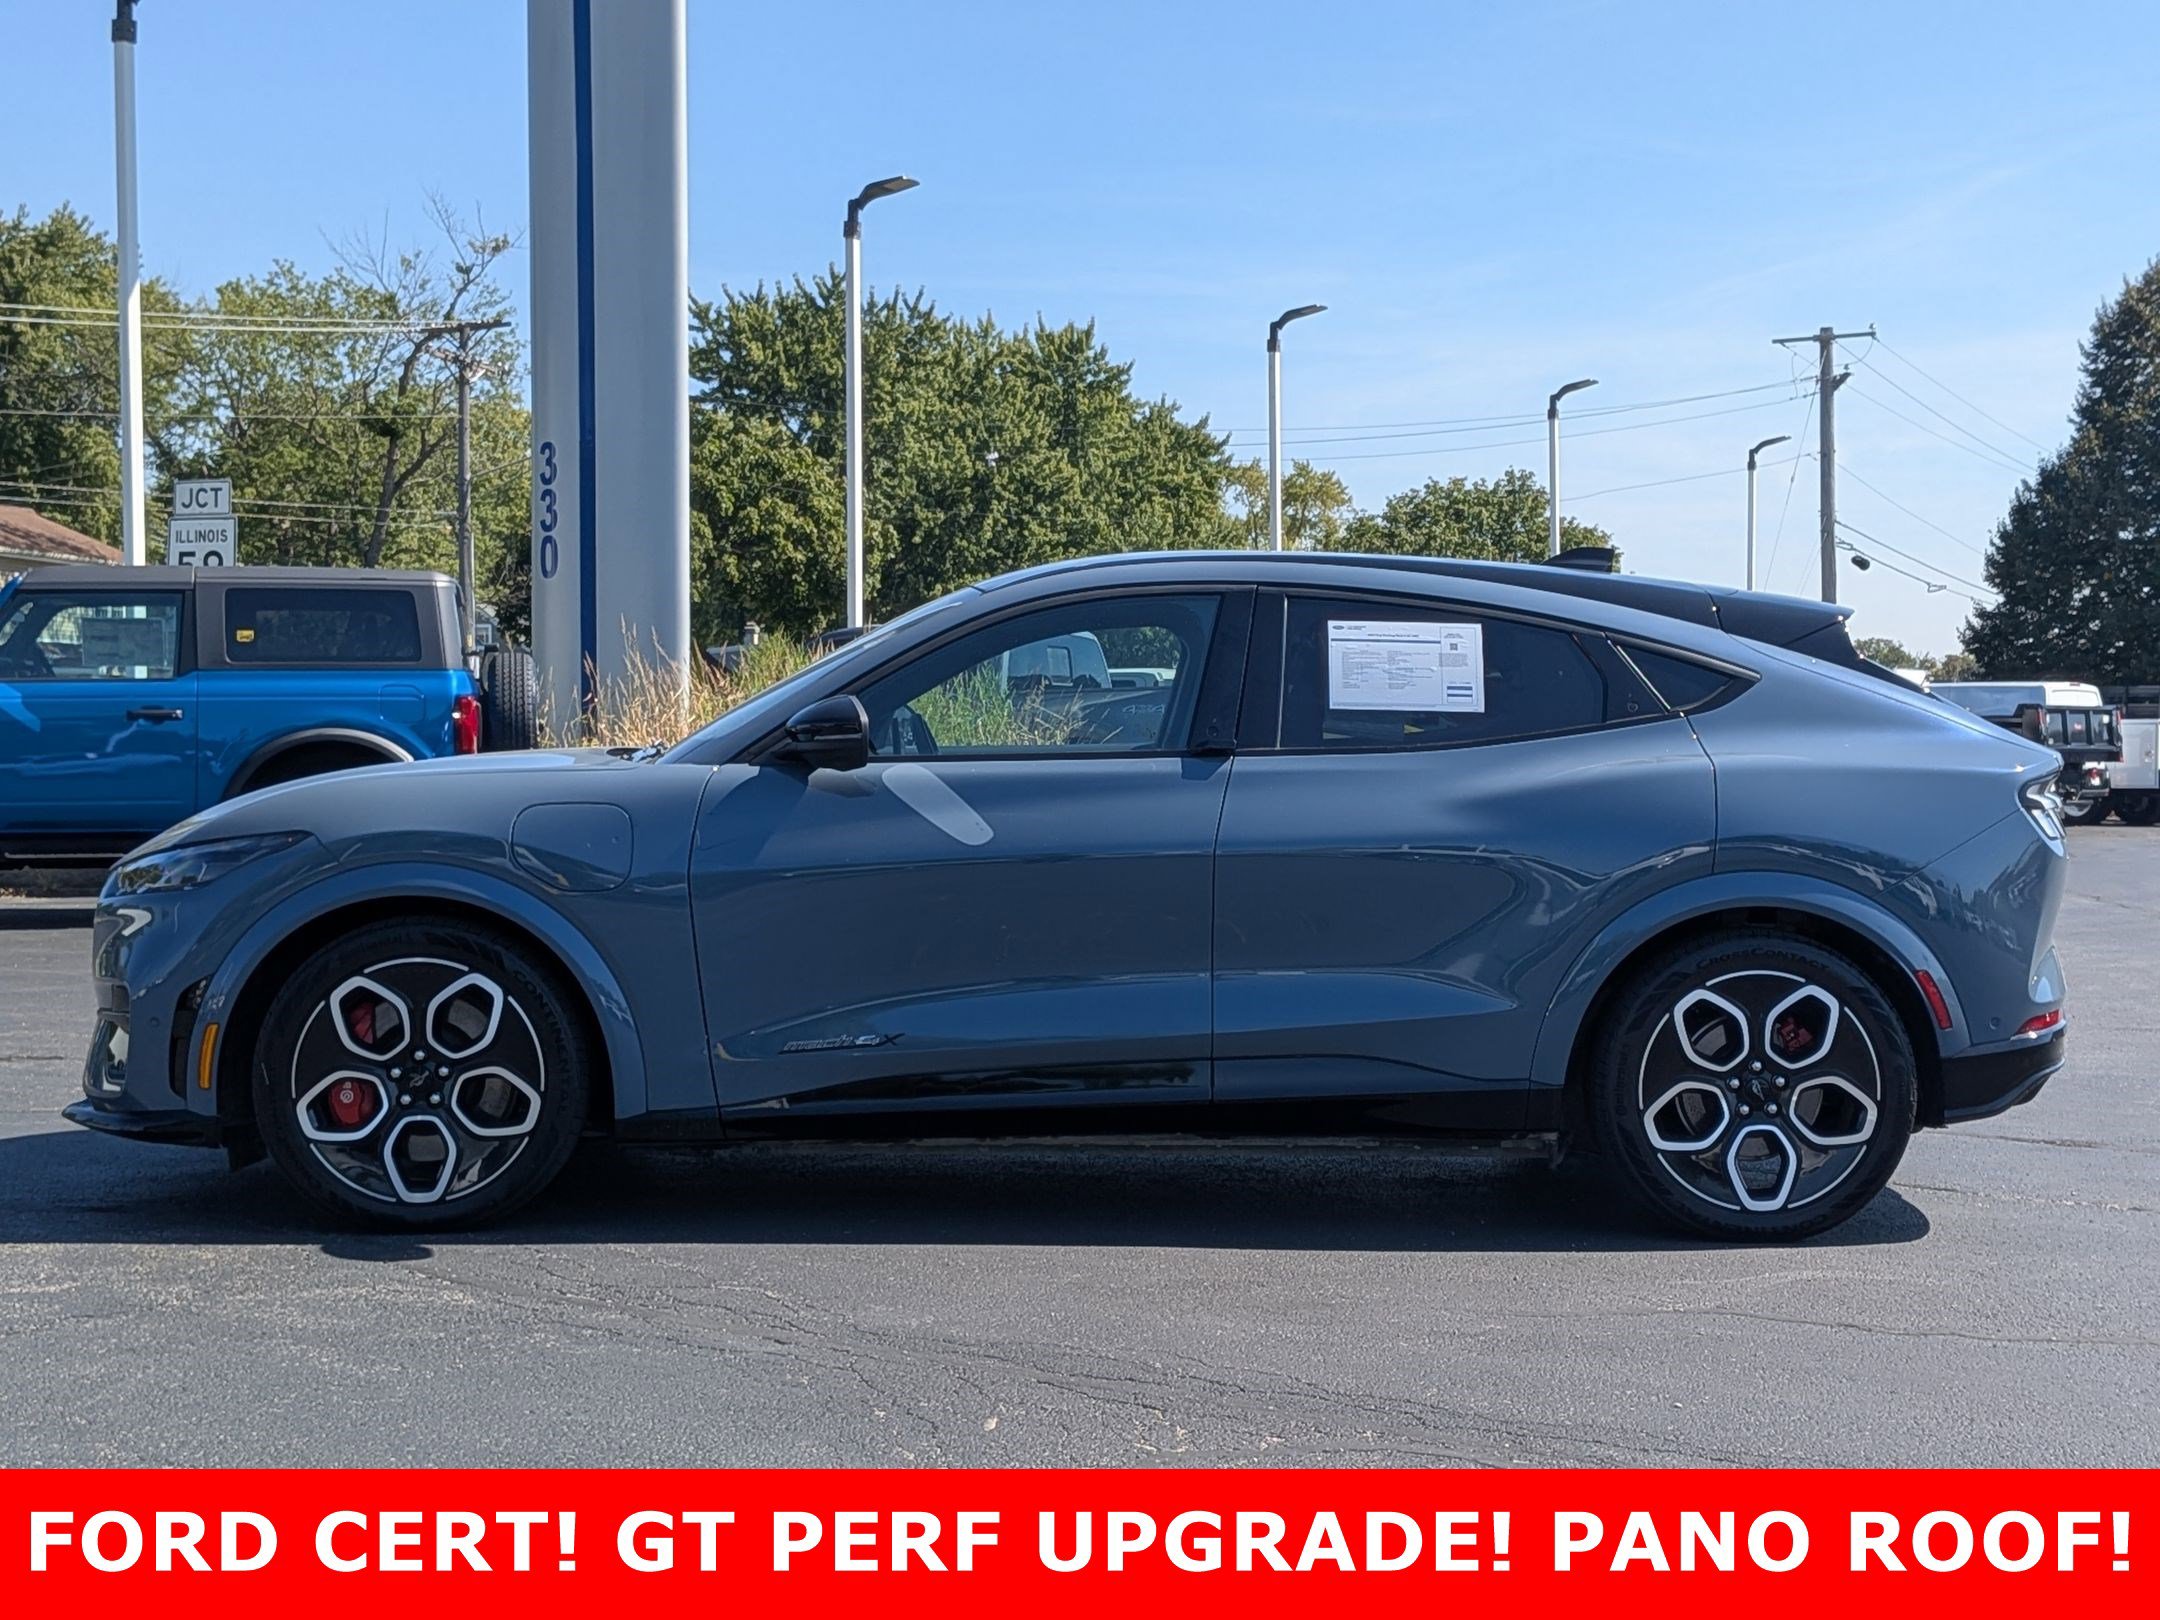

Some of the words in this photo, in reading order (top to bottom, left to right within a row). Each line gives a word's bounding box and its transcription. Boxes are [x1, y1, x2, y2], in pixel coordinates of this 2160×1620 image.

[181, 487, 223, 509] JCT
[539, 441, 559, 579] 330
[175, 529, 228, 544] ILLINOIS
